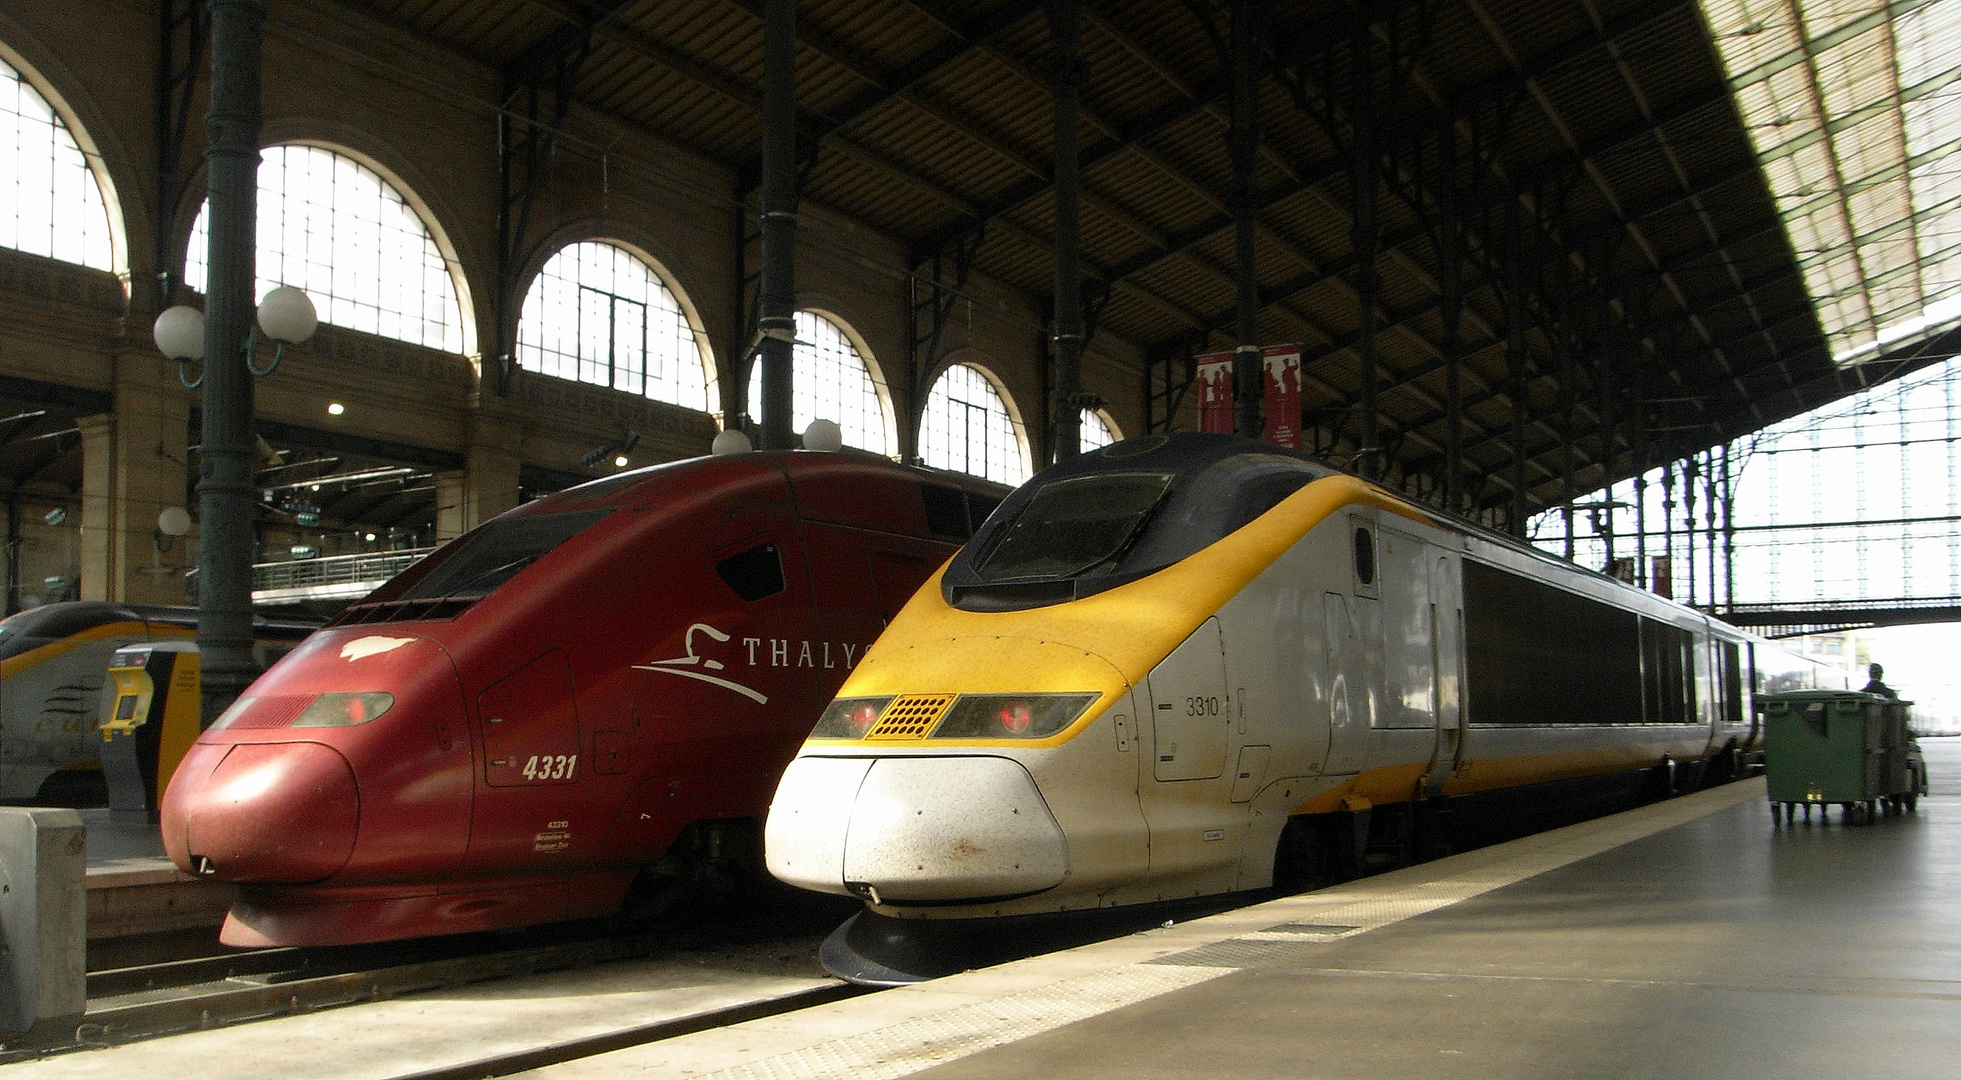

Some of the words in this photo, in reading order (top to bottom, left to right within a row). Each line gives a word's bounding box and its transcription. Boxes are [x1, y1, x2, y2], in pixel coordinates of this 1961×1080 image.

[743, 637, 872, 669] THALY
[1186, 697, 1218, 716] 3310
[522, 754, 577, 781] 4331
